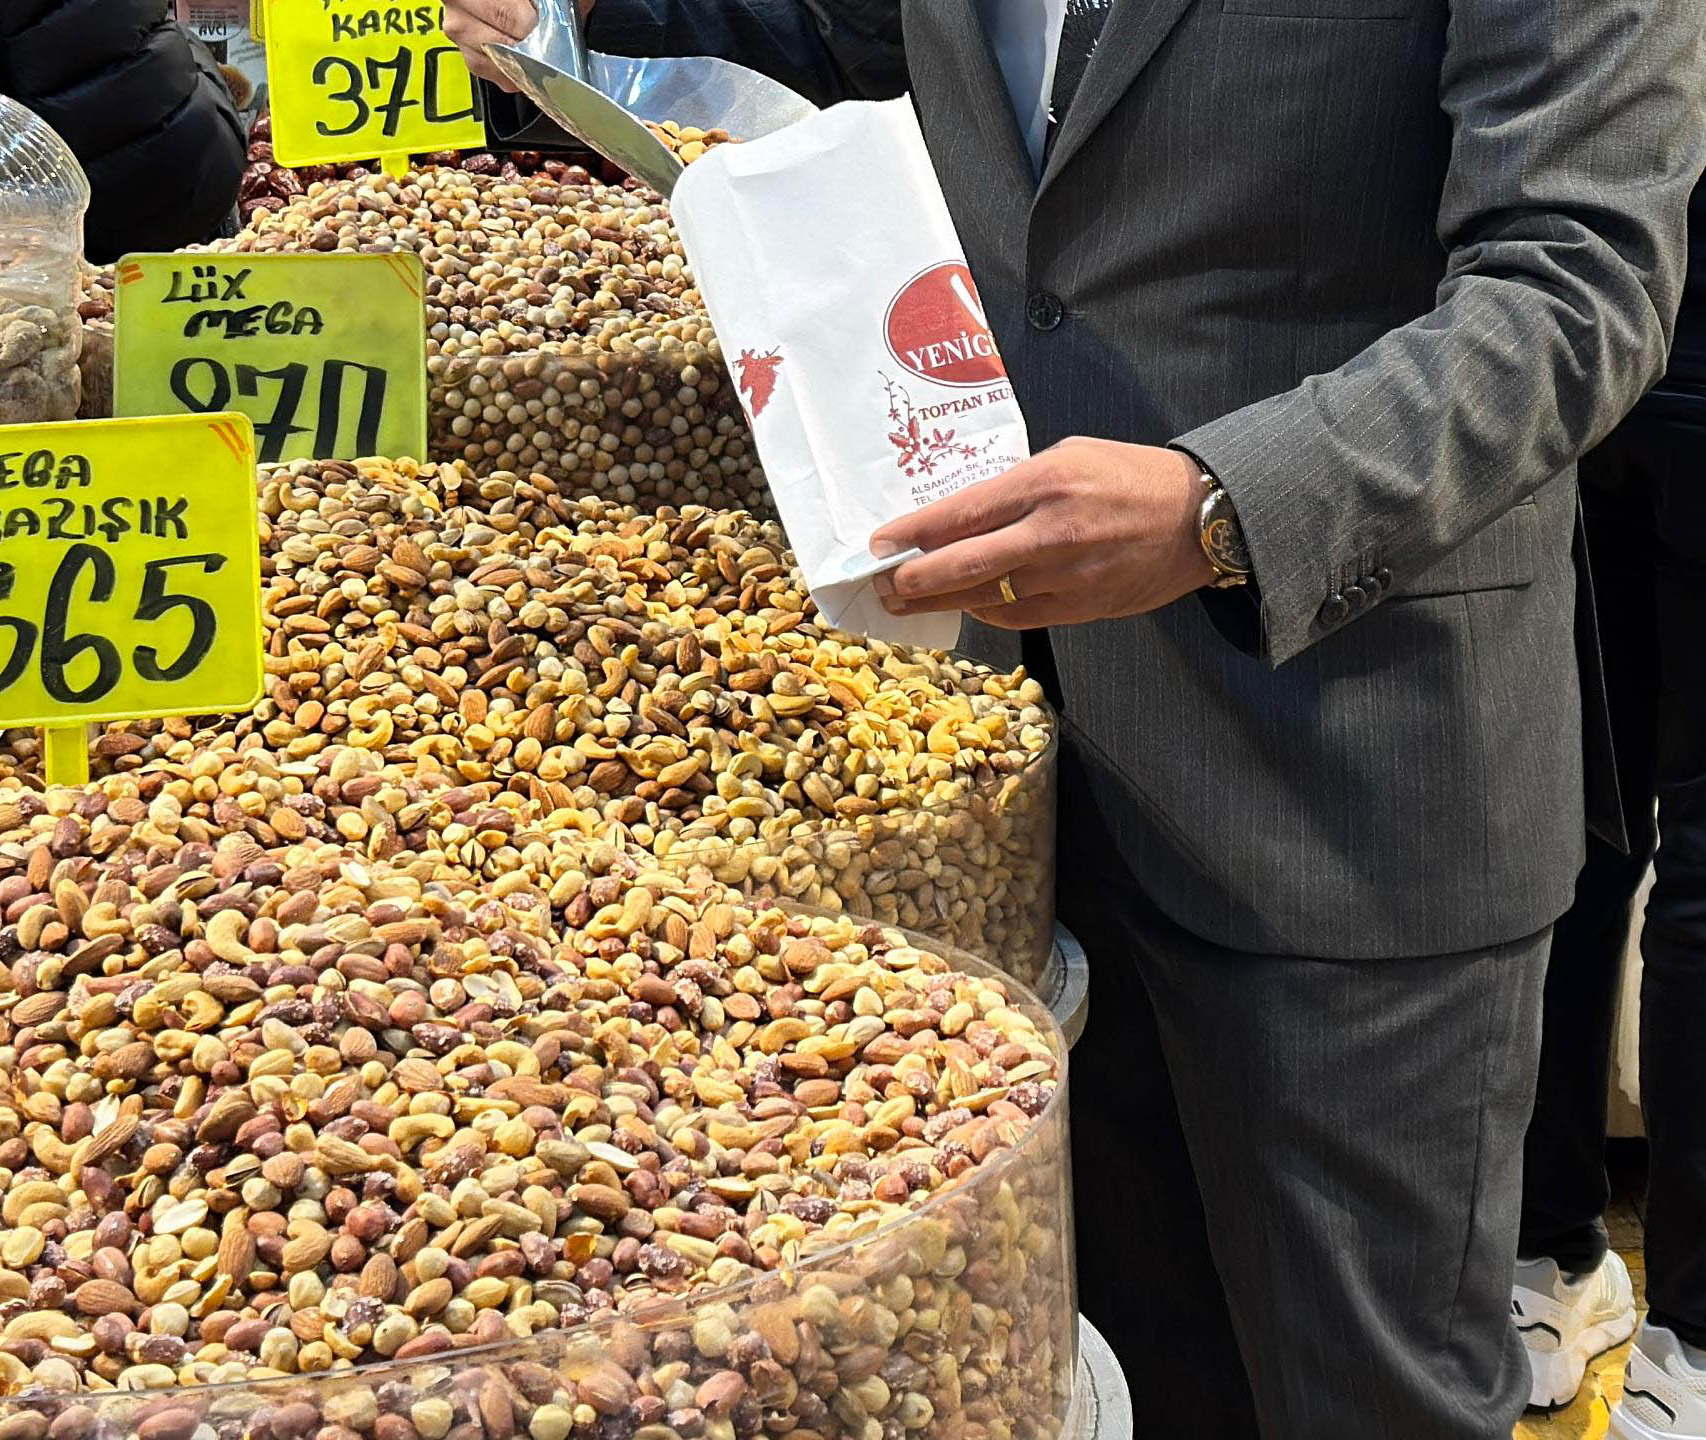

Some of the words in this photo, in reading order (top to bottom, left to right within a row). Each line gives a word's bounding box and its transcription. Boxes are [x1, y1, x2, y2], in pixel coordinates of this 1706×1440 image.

[199, 25, 227, 37] AVCI
[332, 6, 444, 43] KARIŞI
[312, 45, 484, 137] 370
[183, 300, 325, 339] MEGA
[905, 329, 1001, 373] YENİG
[917, 393, 984, 421] TOPTAN
[910, 466, 964, 496] ALSANCAK
